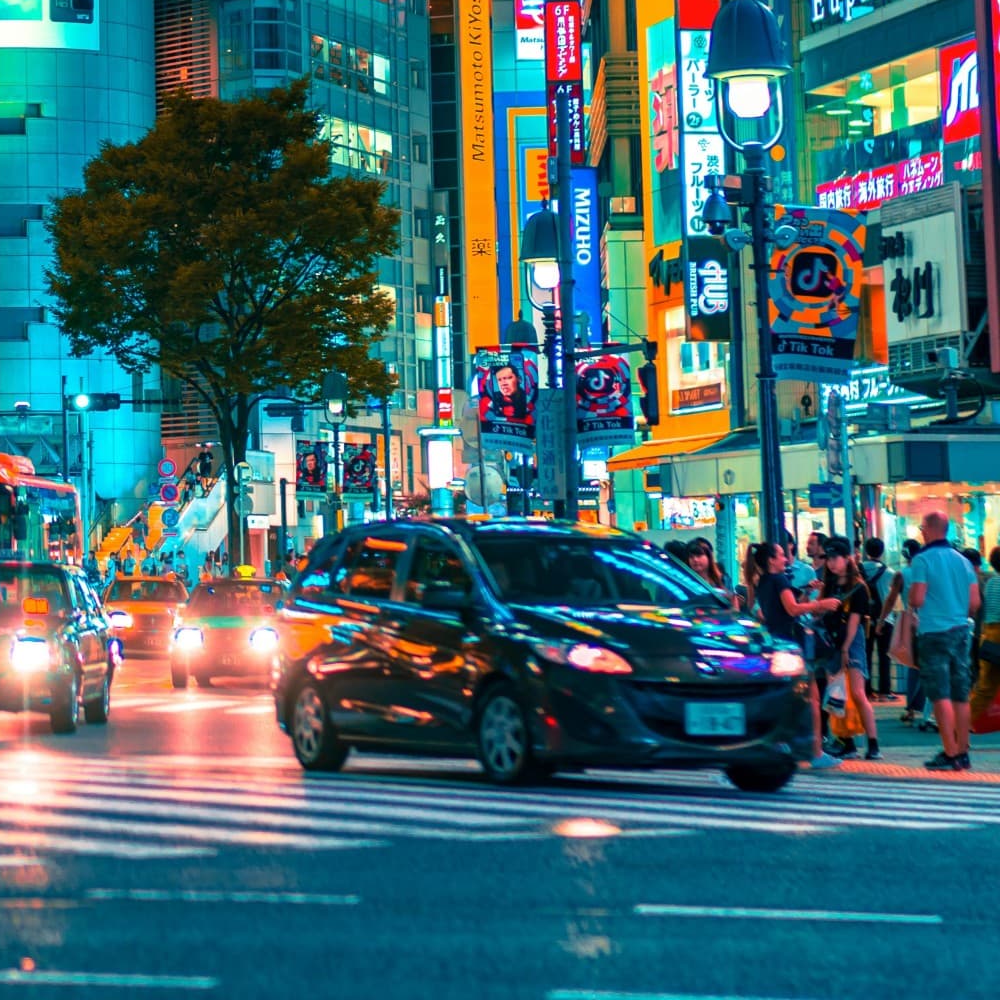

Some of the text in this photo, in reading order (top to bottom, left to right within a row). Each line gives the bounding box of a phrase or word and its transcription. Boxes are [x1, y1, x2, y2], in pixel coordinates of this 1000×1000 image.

[554, 4, 570, 16] 6F
[858, 173, 895, 204] 海外旅行
[574, 187, 591, 265] MIZUHO
[698, 260, 729, 315] HUB
